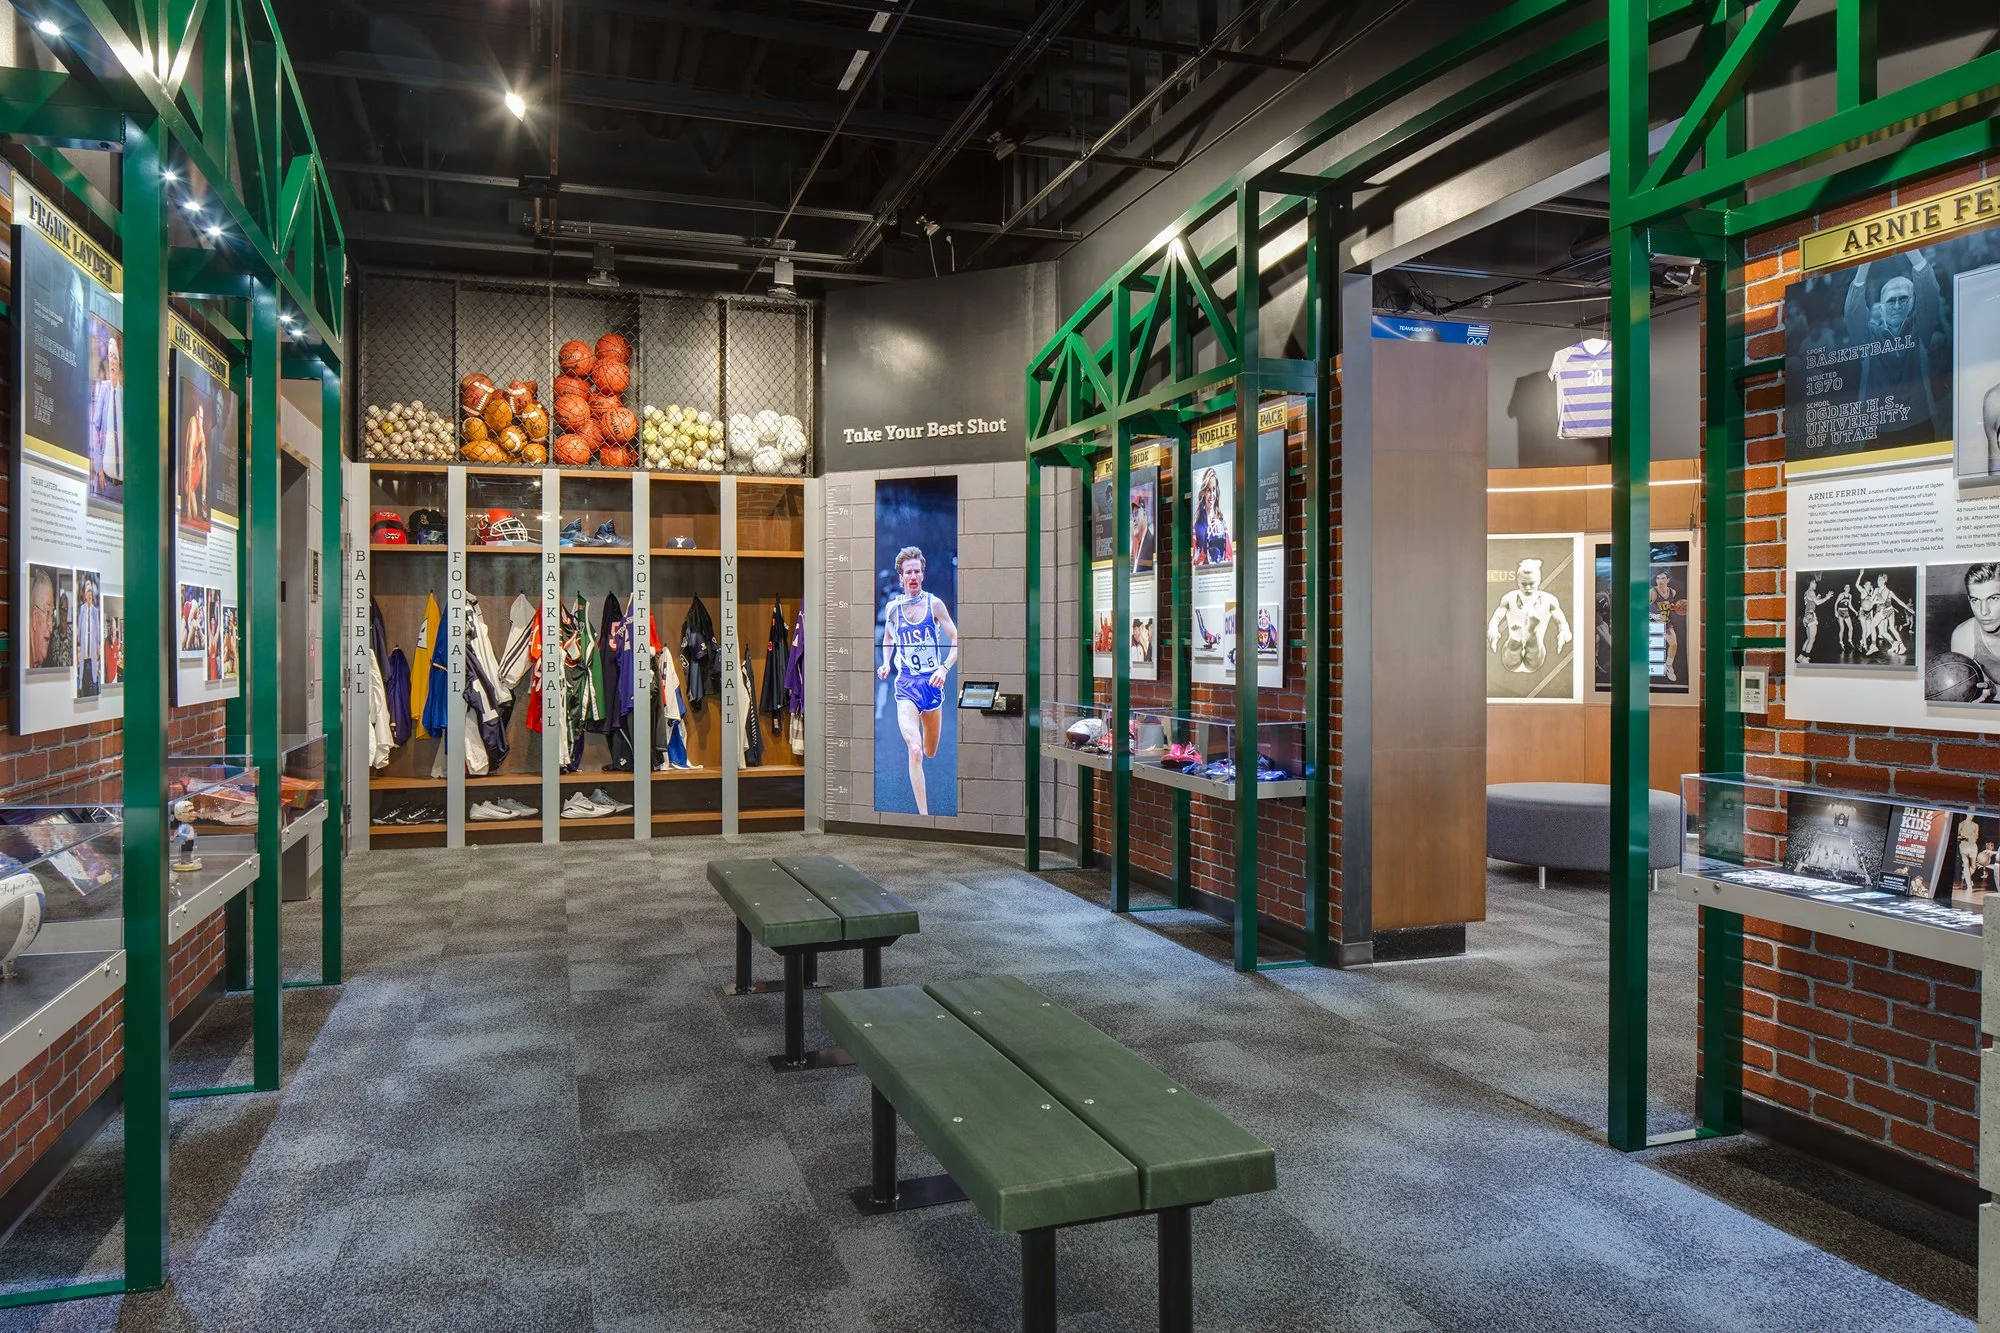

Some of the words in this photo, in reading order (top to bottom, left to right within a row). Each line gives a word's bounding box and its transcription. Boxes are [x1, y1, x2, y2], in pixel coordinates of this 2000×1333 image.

[1843, 204, 1940, 252] ARNIE
[1954, 186, 2000, 220] FE
[29, 195, 71, 250] FRANK
[72, 233, 112, 285] LAYDEN
[1806, 335, 1915, 369] BASKETBALL
[1807, 346, 1827, 356] SPORT
[1587, 370, 1603, 386] 20
[1806, 371, 1837, 383] INDUCTED
[1806, 377, 1843, 396] 1970
[1806, 400, 1830, 409] SCHOOL
[1806, 401, 1861, 422] OGDEN
[1867, 396, 1904, 412] H.S.,
[1199, 425, 1230, 444] NOELLE
[1259, 408, 1282, 426] PACE
[1806, 407, 1911, 436] UNIVERSITY
[844, 428, 882, 444] Take
[885, 425, 925, 441] Your
[927, 421, 964, 437] Best
[967, 418, 1007, 434] Shot
[1806, 434, 1827, 448] OF
[1831, 426, 1878, 444] UTAH
[1808, 491, 1834, 500] ARNIE
[839, 508, 849, 516] 7ft
[675, 537, 687, 547] Y
[839, 554, 849, 562] 6ft
[839, 601, 849, 609] 5ft
[355, 550, 366, 694] BASEBALL
[451, 551, 462, 693] FOOTBALL
[636, 554, 647, 689] SOFTBALL
[545, 553, 556, 727] BASKETBALL
[724, 556, 735, 724] VOLLEYBALL
[902, 627, 934, 644] USA
[839, 647, 849, 655] 4ft
[838, 693, 849, 701] 3ft
[838, 740, 849, 748] 2ft
[838, 785, 848, 794] 1ft
[1903, 806, 1934, 820] BLITZ
[1900, 816, 1932, 832] KIDS
